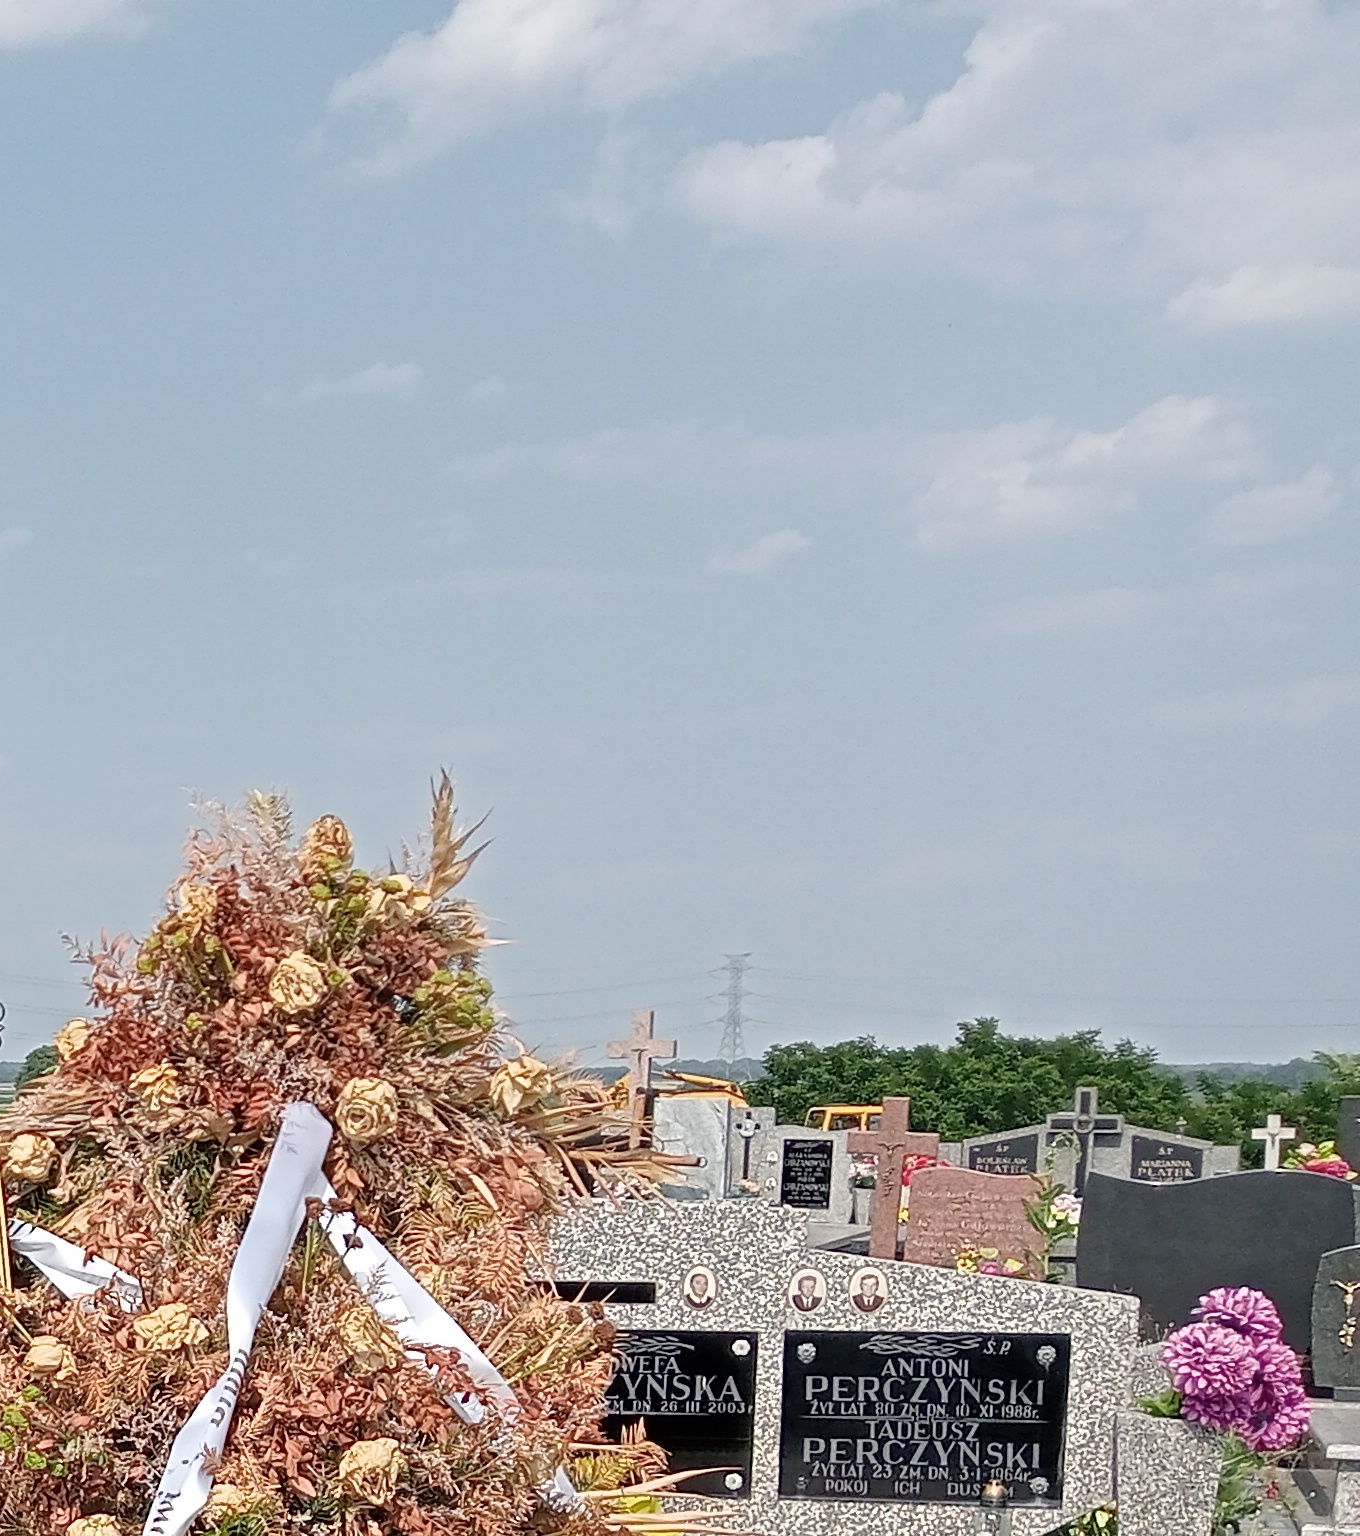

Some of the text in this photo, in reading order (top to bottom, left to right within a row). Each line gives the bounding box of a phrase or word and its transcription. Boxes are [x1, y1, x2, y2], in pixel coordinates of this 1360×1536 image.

[880, 1357, 970, 1378] ANTONI
[840, 1401, 864, 1416] LAT
[865, 1420, 980, 1442] TADEUSZ
[841, 1463, 865, 1478] LAT
[872, 1464, 893, 1479] 23
[894, 1481, 921, 1496] ICH
